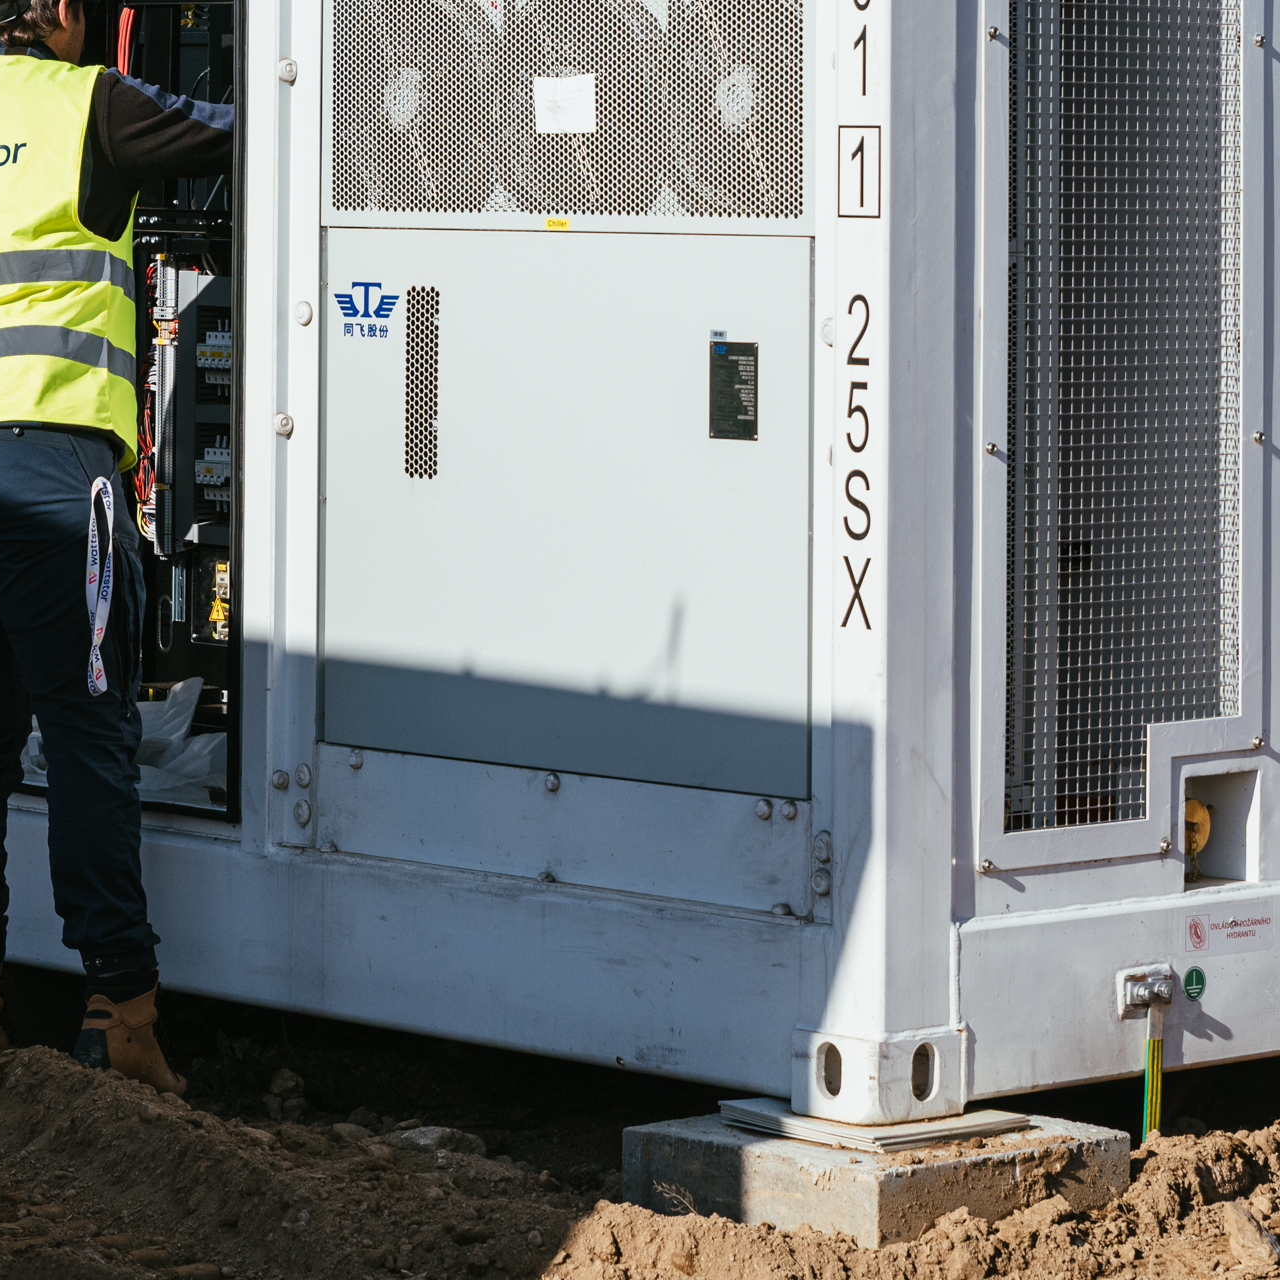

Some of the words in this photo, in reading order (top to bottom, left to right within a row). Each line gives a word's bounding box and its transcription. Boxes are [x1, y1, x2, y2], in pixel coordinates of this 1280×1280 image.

[547, 219, 568, 228] Chiller
[343, 322, 389, 338] 同飞股份
[841, 293, 872, 630] 25SX
